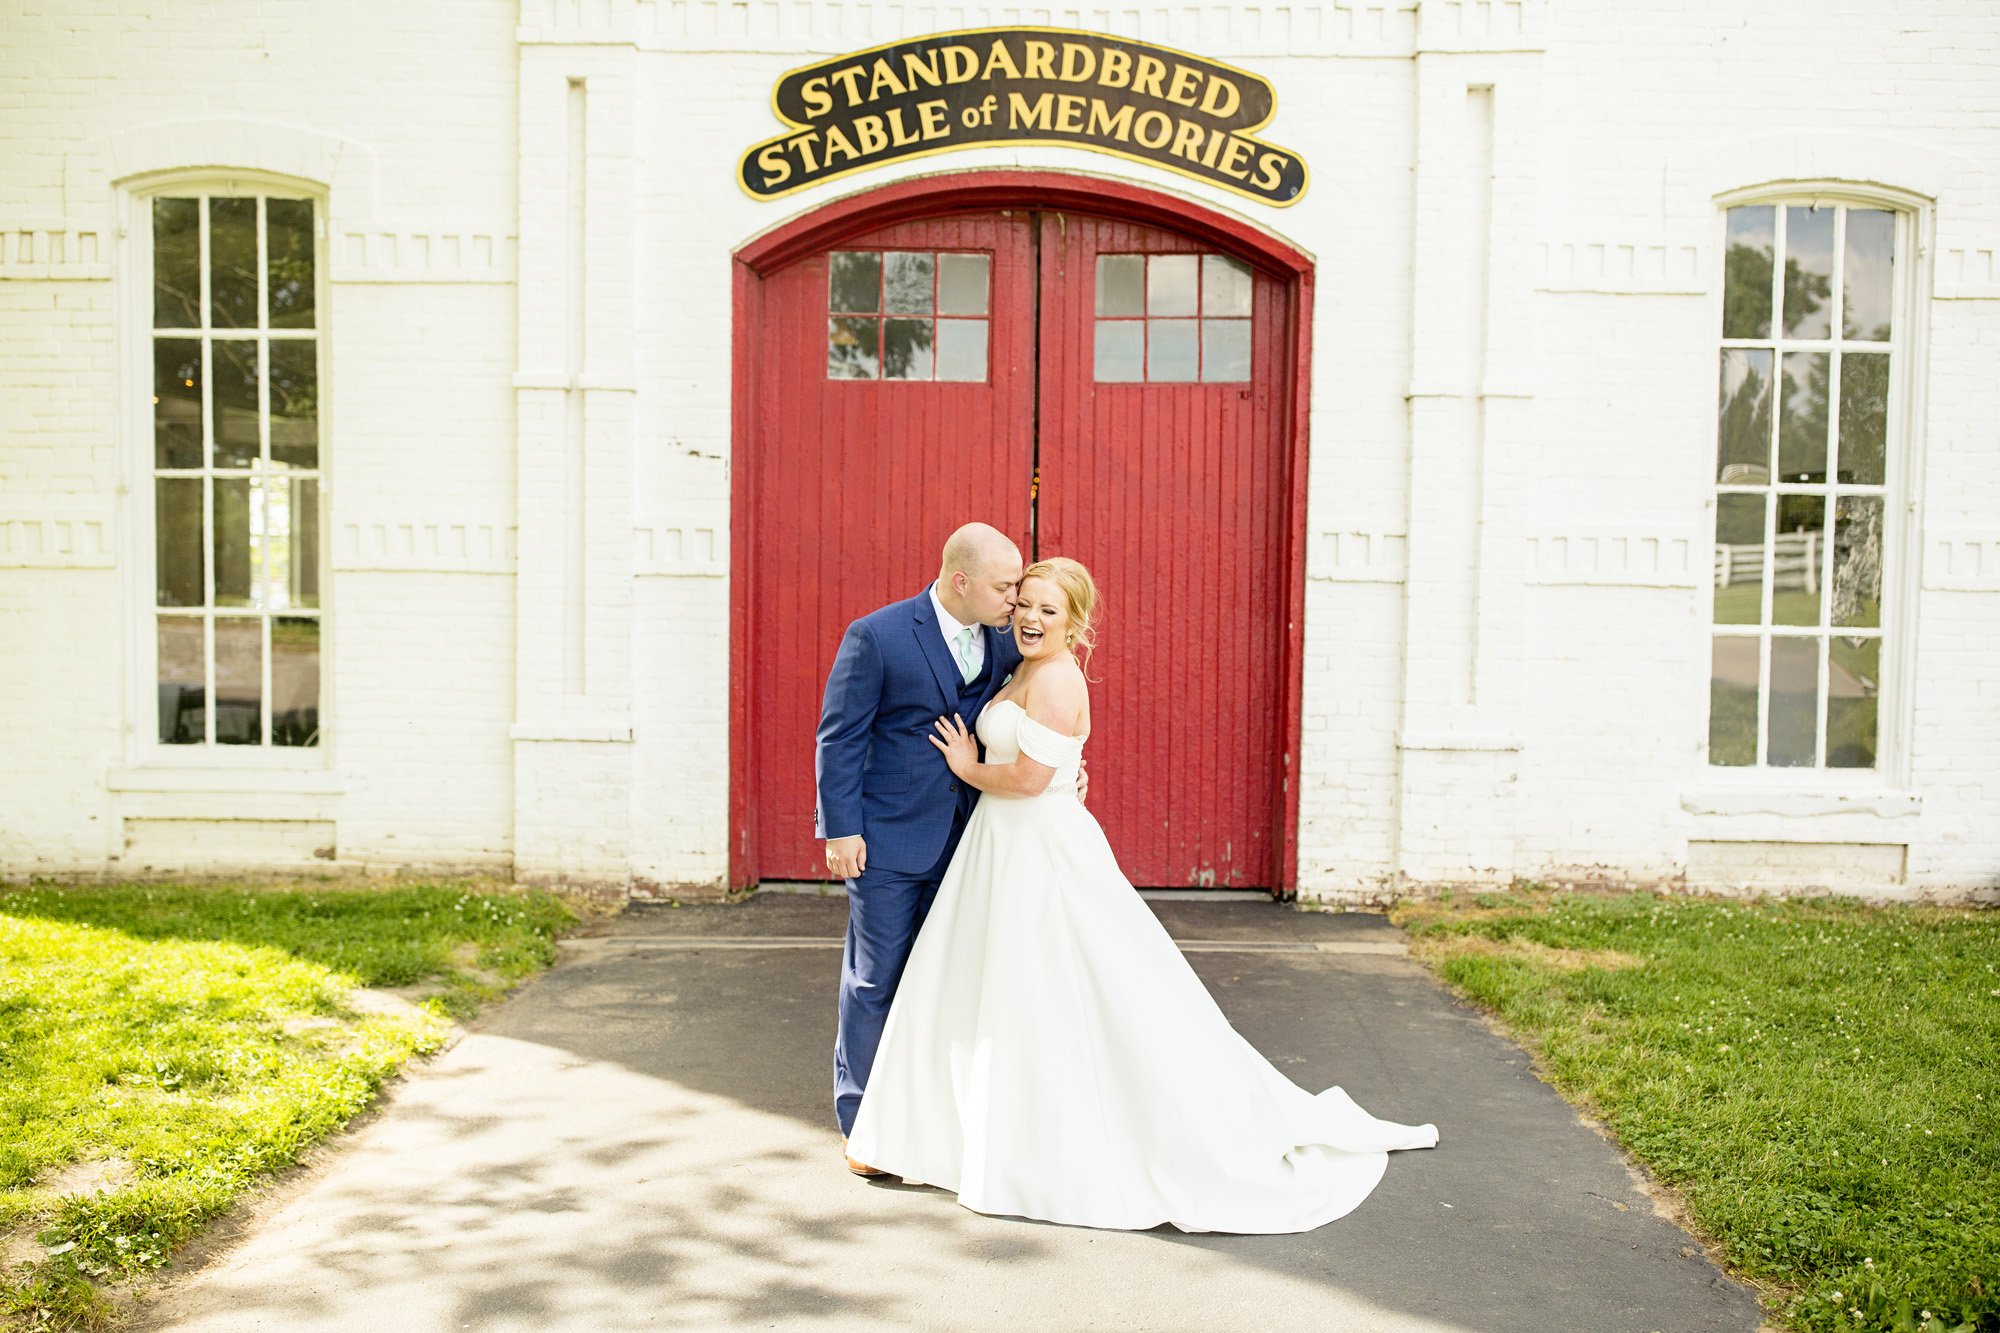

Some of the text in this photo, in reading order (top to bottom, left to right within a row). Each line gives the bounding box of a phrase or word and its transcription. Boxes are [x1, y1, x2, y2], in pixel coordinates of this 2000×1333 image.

[800, 38, 1241, 120] STANDARDBRED
[757, 92, 1289, 191] STABLE of MEMORIES
